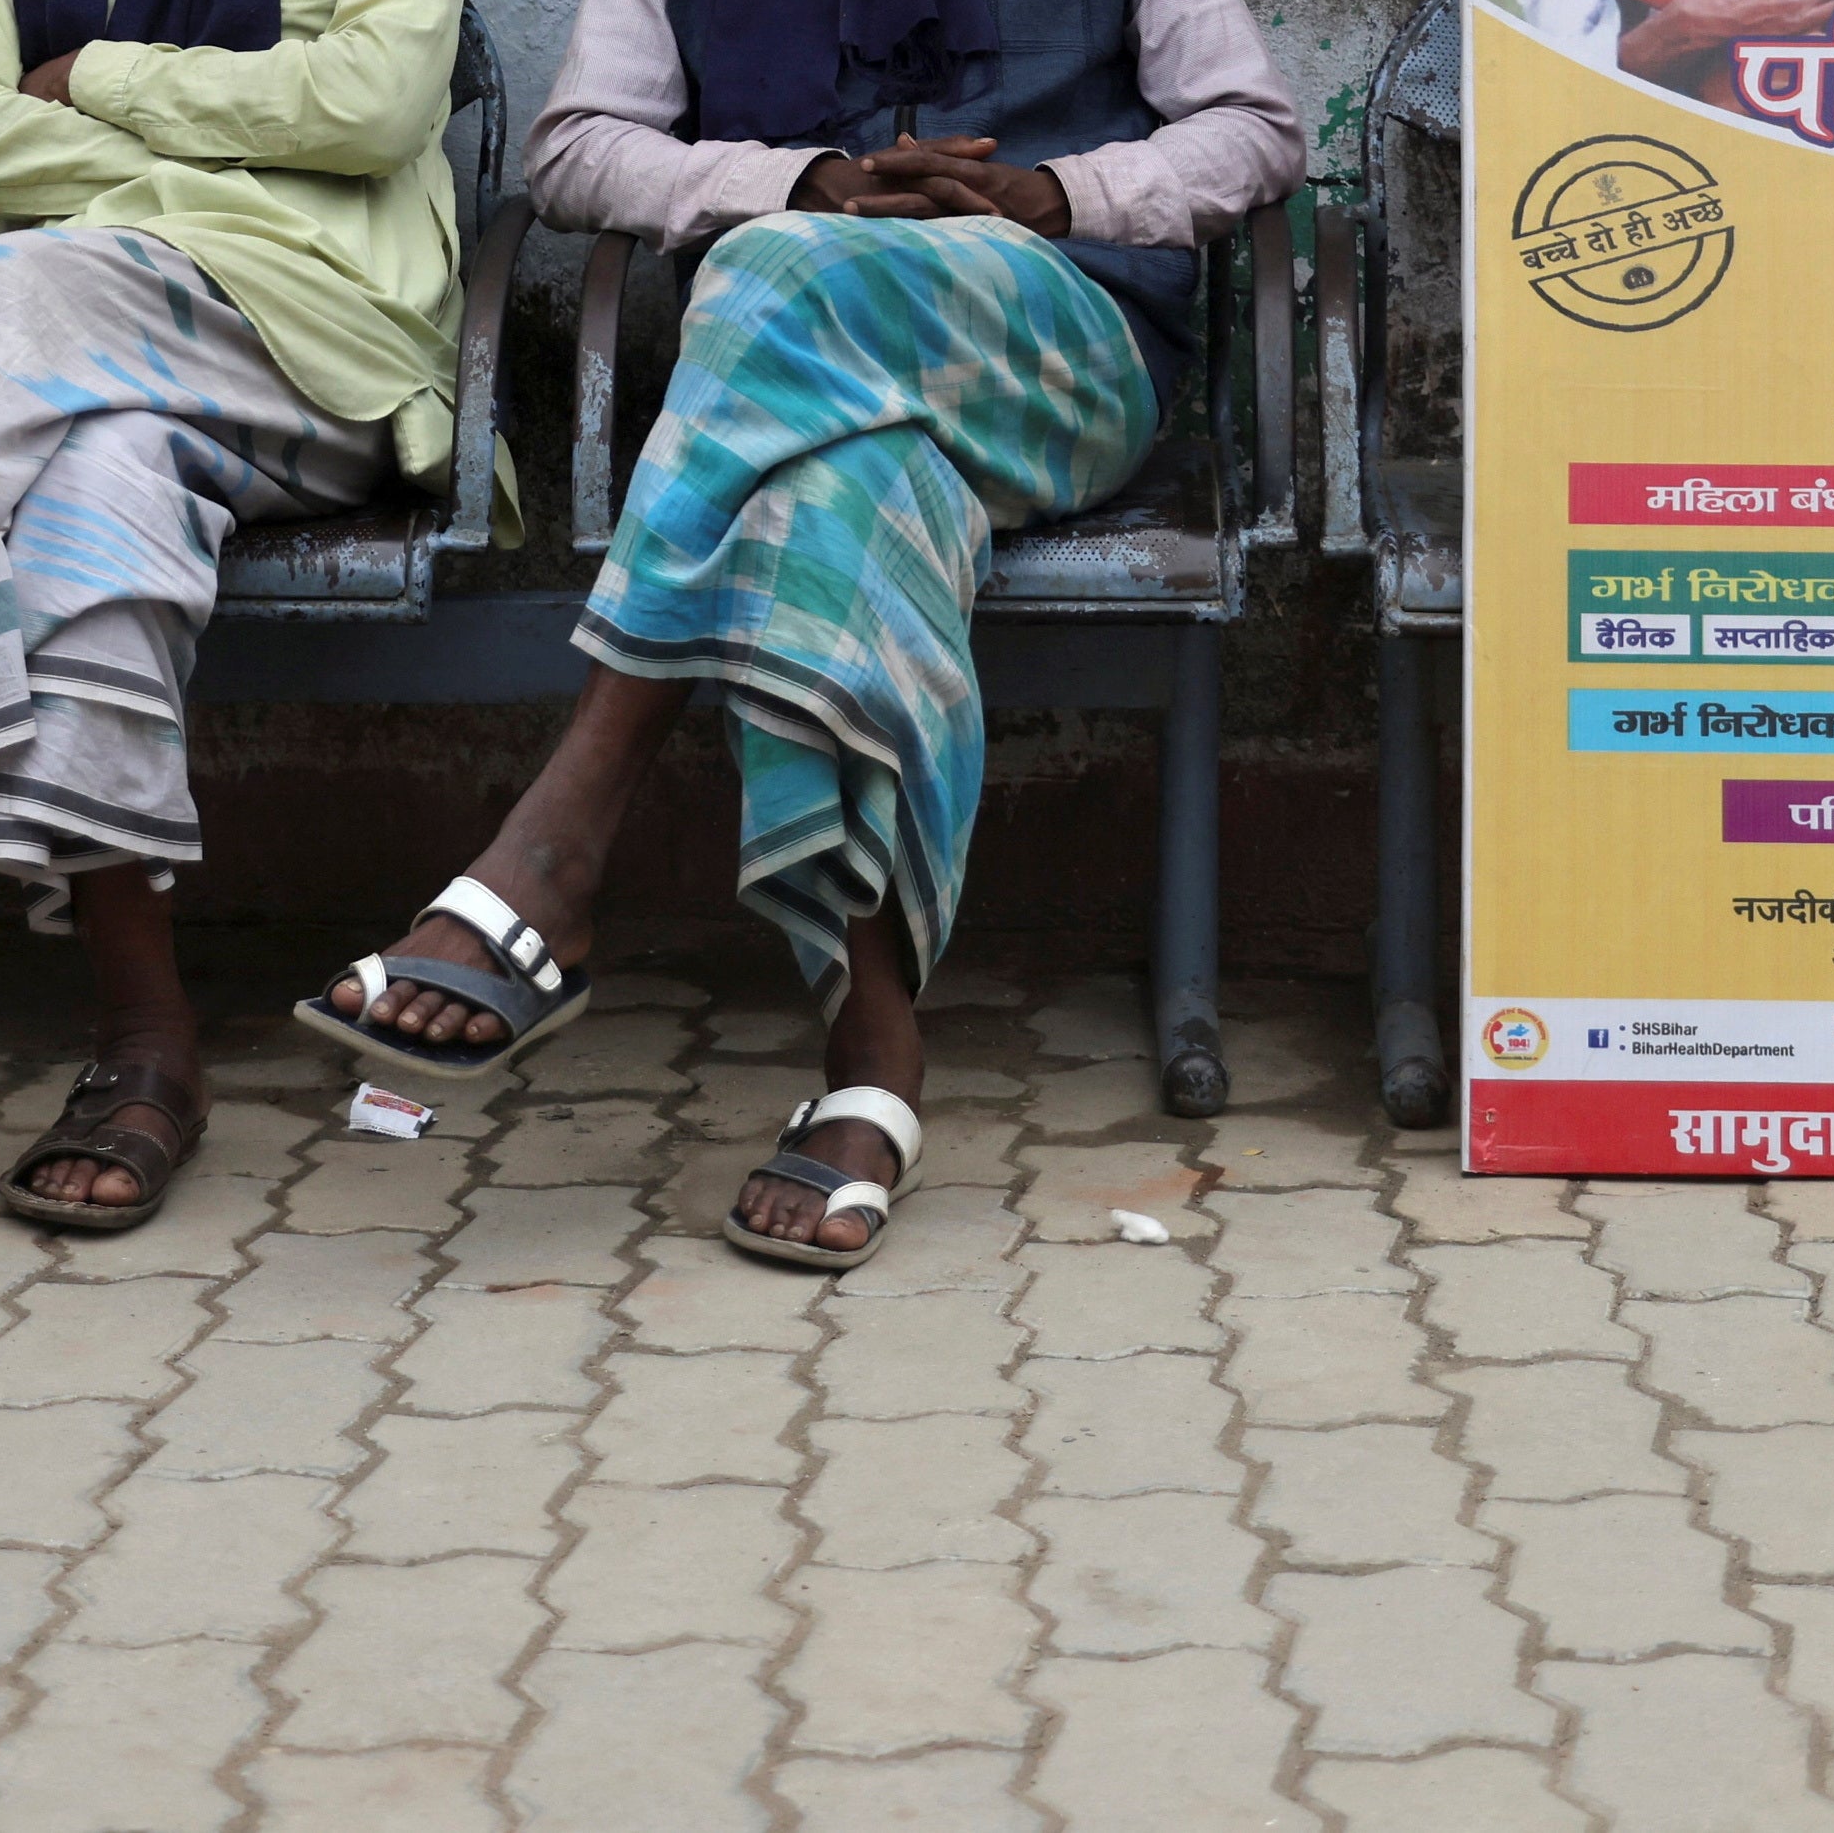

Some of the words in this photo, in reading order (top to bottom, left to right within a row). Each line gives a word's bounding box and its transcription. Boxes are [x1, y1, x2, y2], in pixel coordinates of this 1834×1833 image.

[1519, 231, 1580, 270] बच्चे
[1584, 221, 1618, 253] दो
[1621, 210, 1656, 247] ही
[1662, 192, 1724, 232] अच्छे
[1646, 478, 1778, 512] महिला
[1590, 570, 1674, 601] गर्भ
[1596, 621, 1675, 649] दैनिक
[1632, 1022, 1698, 1035] SHSBihar
